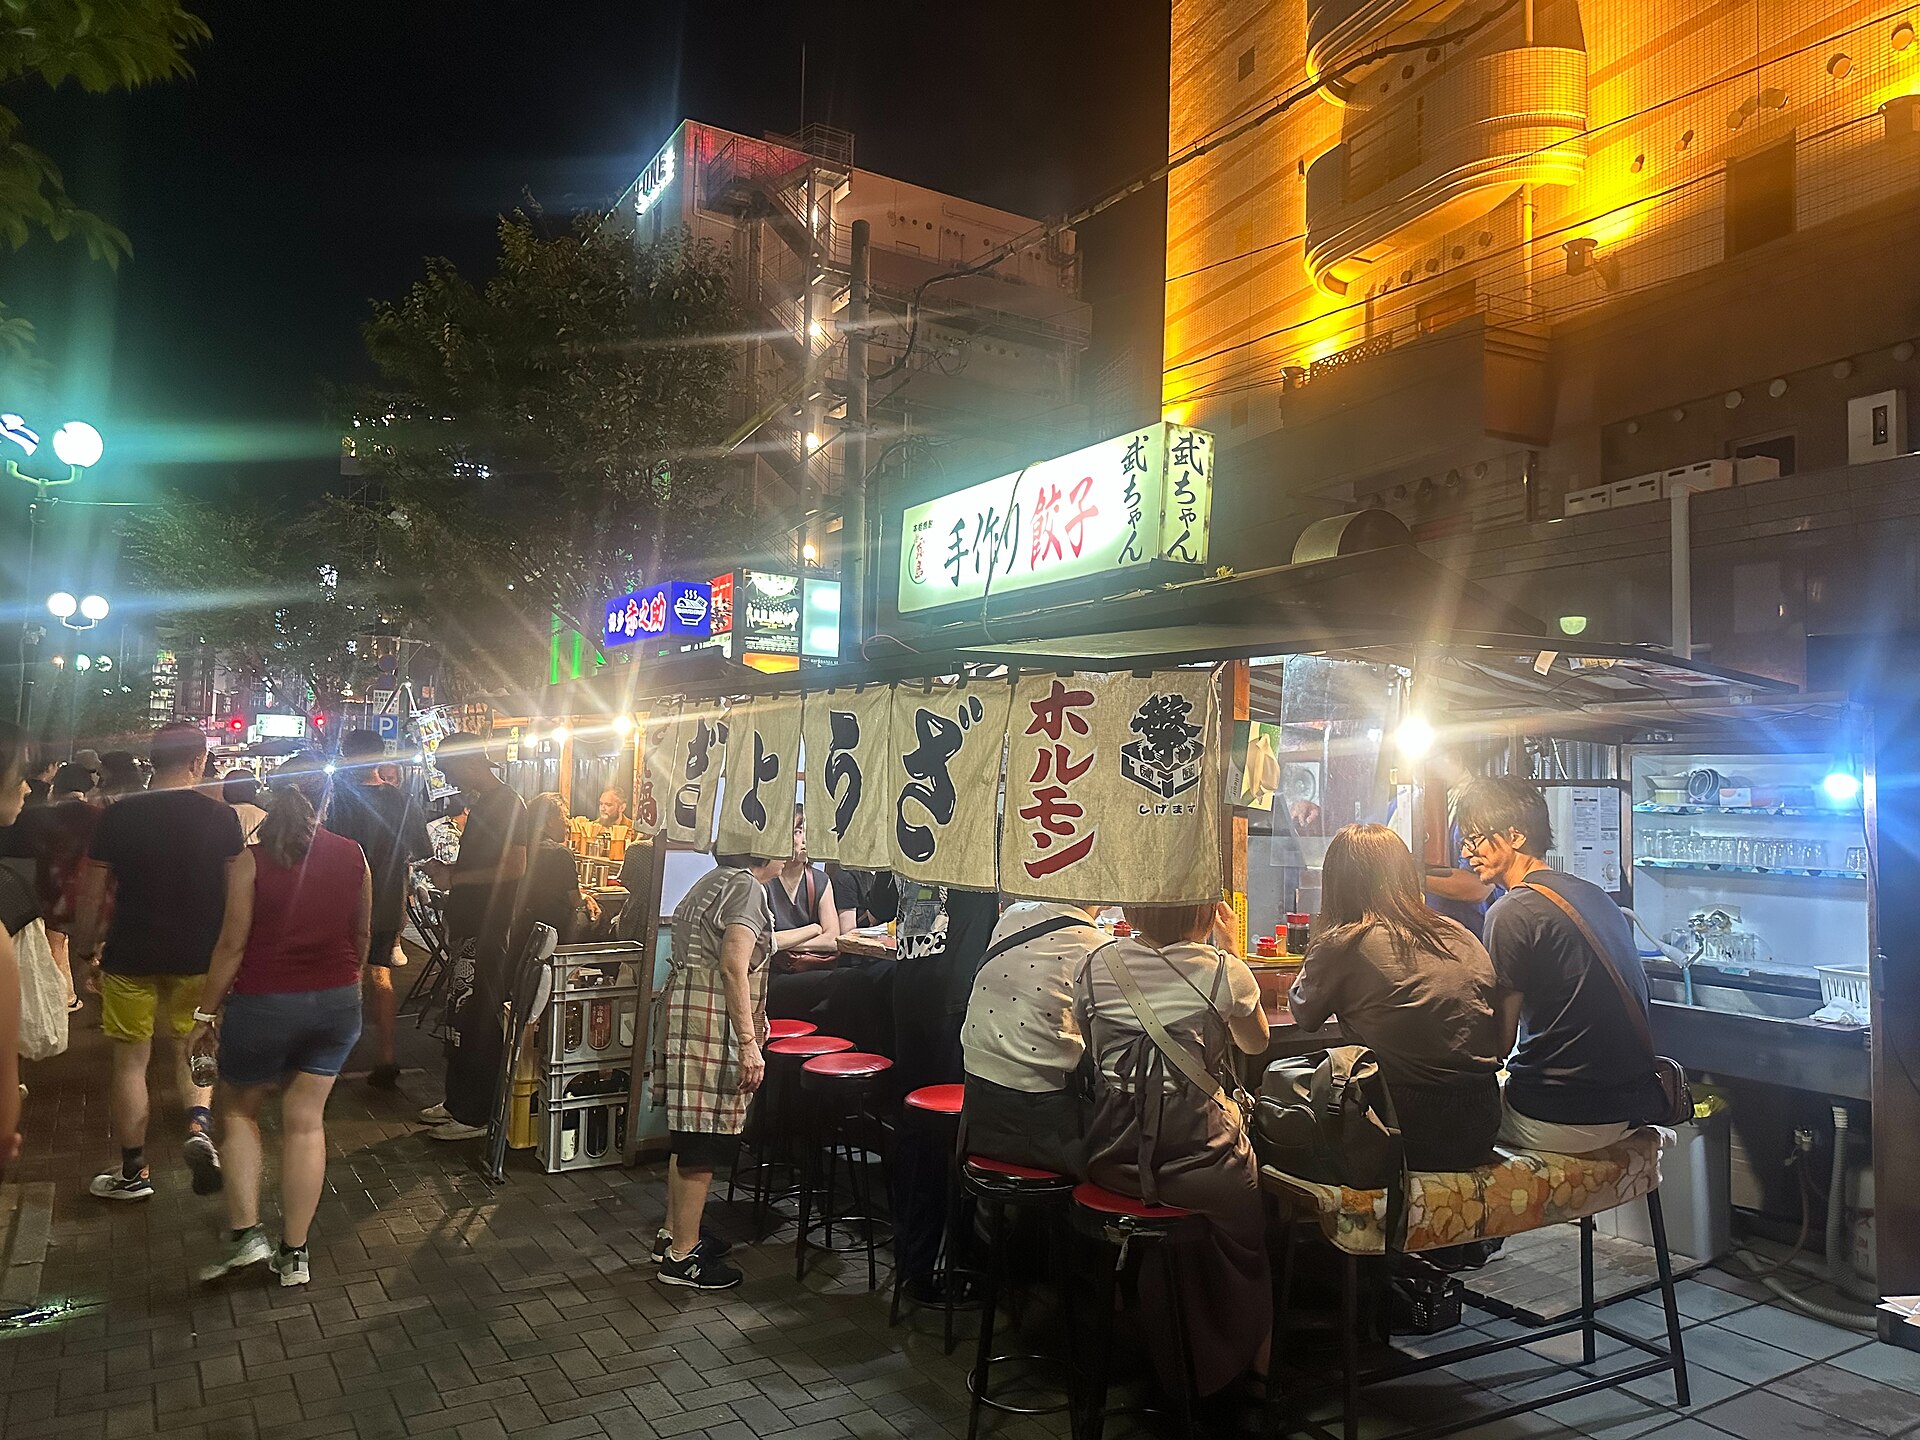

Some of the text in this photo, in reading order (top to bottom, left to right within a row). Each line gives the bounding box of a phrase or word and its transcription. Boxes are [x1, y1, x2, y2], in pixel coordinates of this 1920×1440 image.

[944, 476, 1099, 588] 手作り餃子
[1118, 435, 1149, 565] 武ちゃん
[1167, 432, 1206, 565] 武ちゃん
[378, 717, 394, 737] P
[1019, 679, 1096, 880] ホルモン
